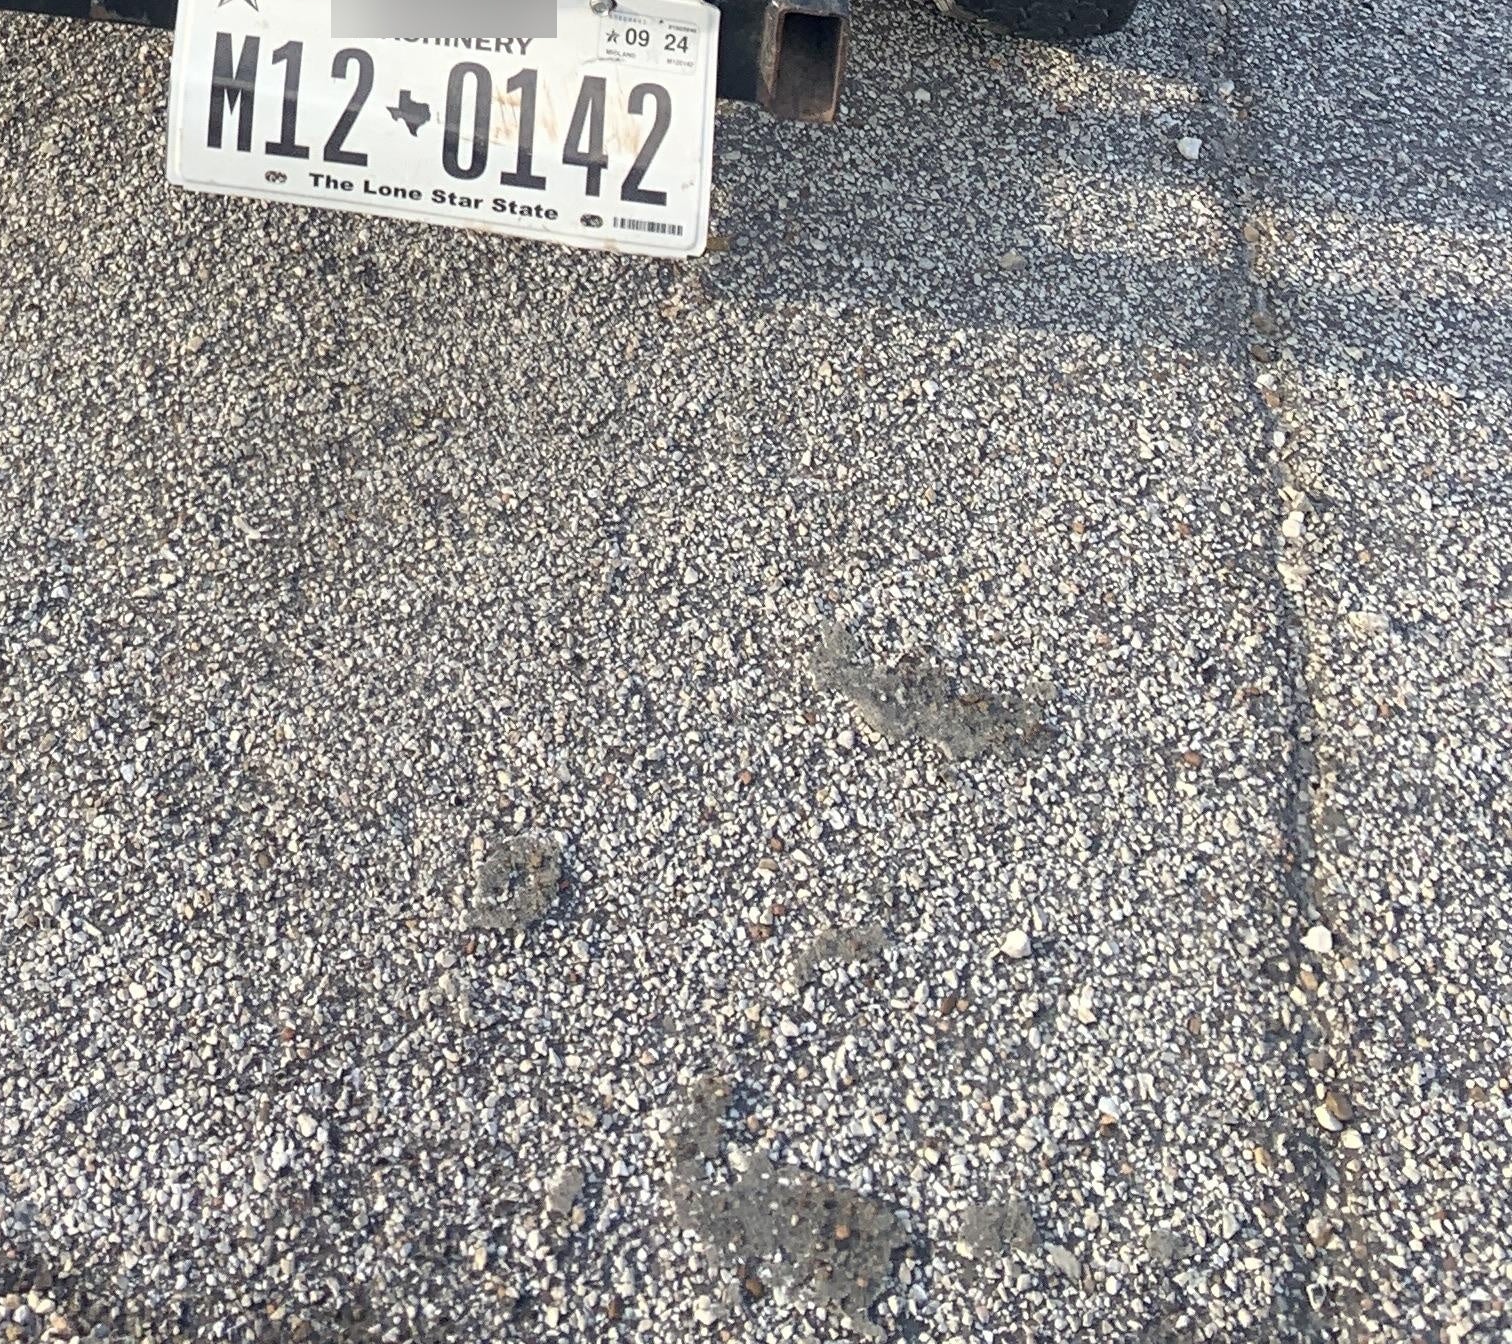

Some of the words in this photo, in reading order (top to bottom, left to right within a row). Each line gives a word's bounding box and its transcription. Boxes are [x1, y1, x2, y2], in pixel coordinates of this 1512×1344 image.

[625, 27, 650, 47] 09
[664, 33, 689, 53] 24
[207, 31, 375, 168] M12
[442, 61, 673, 207] 0142
[309, 173, 354, 194] The
[363, 178, 423, 202] Lone
[431, 188, 483, 211] Star
[491, 197, 560, 222] State
